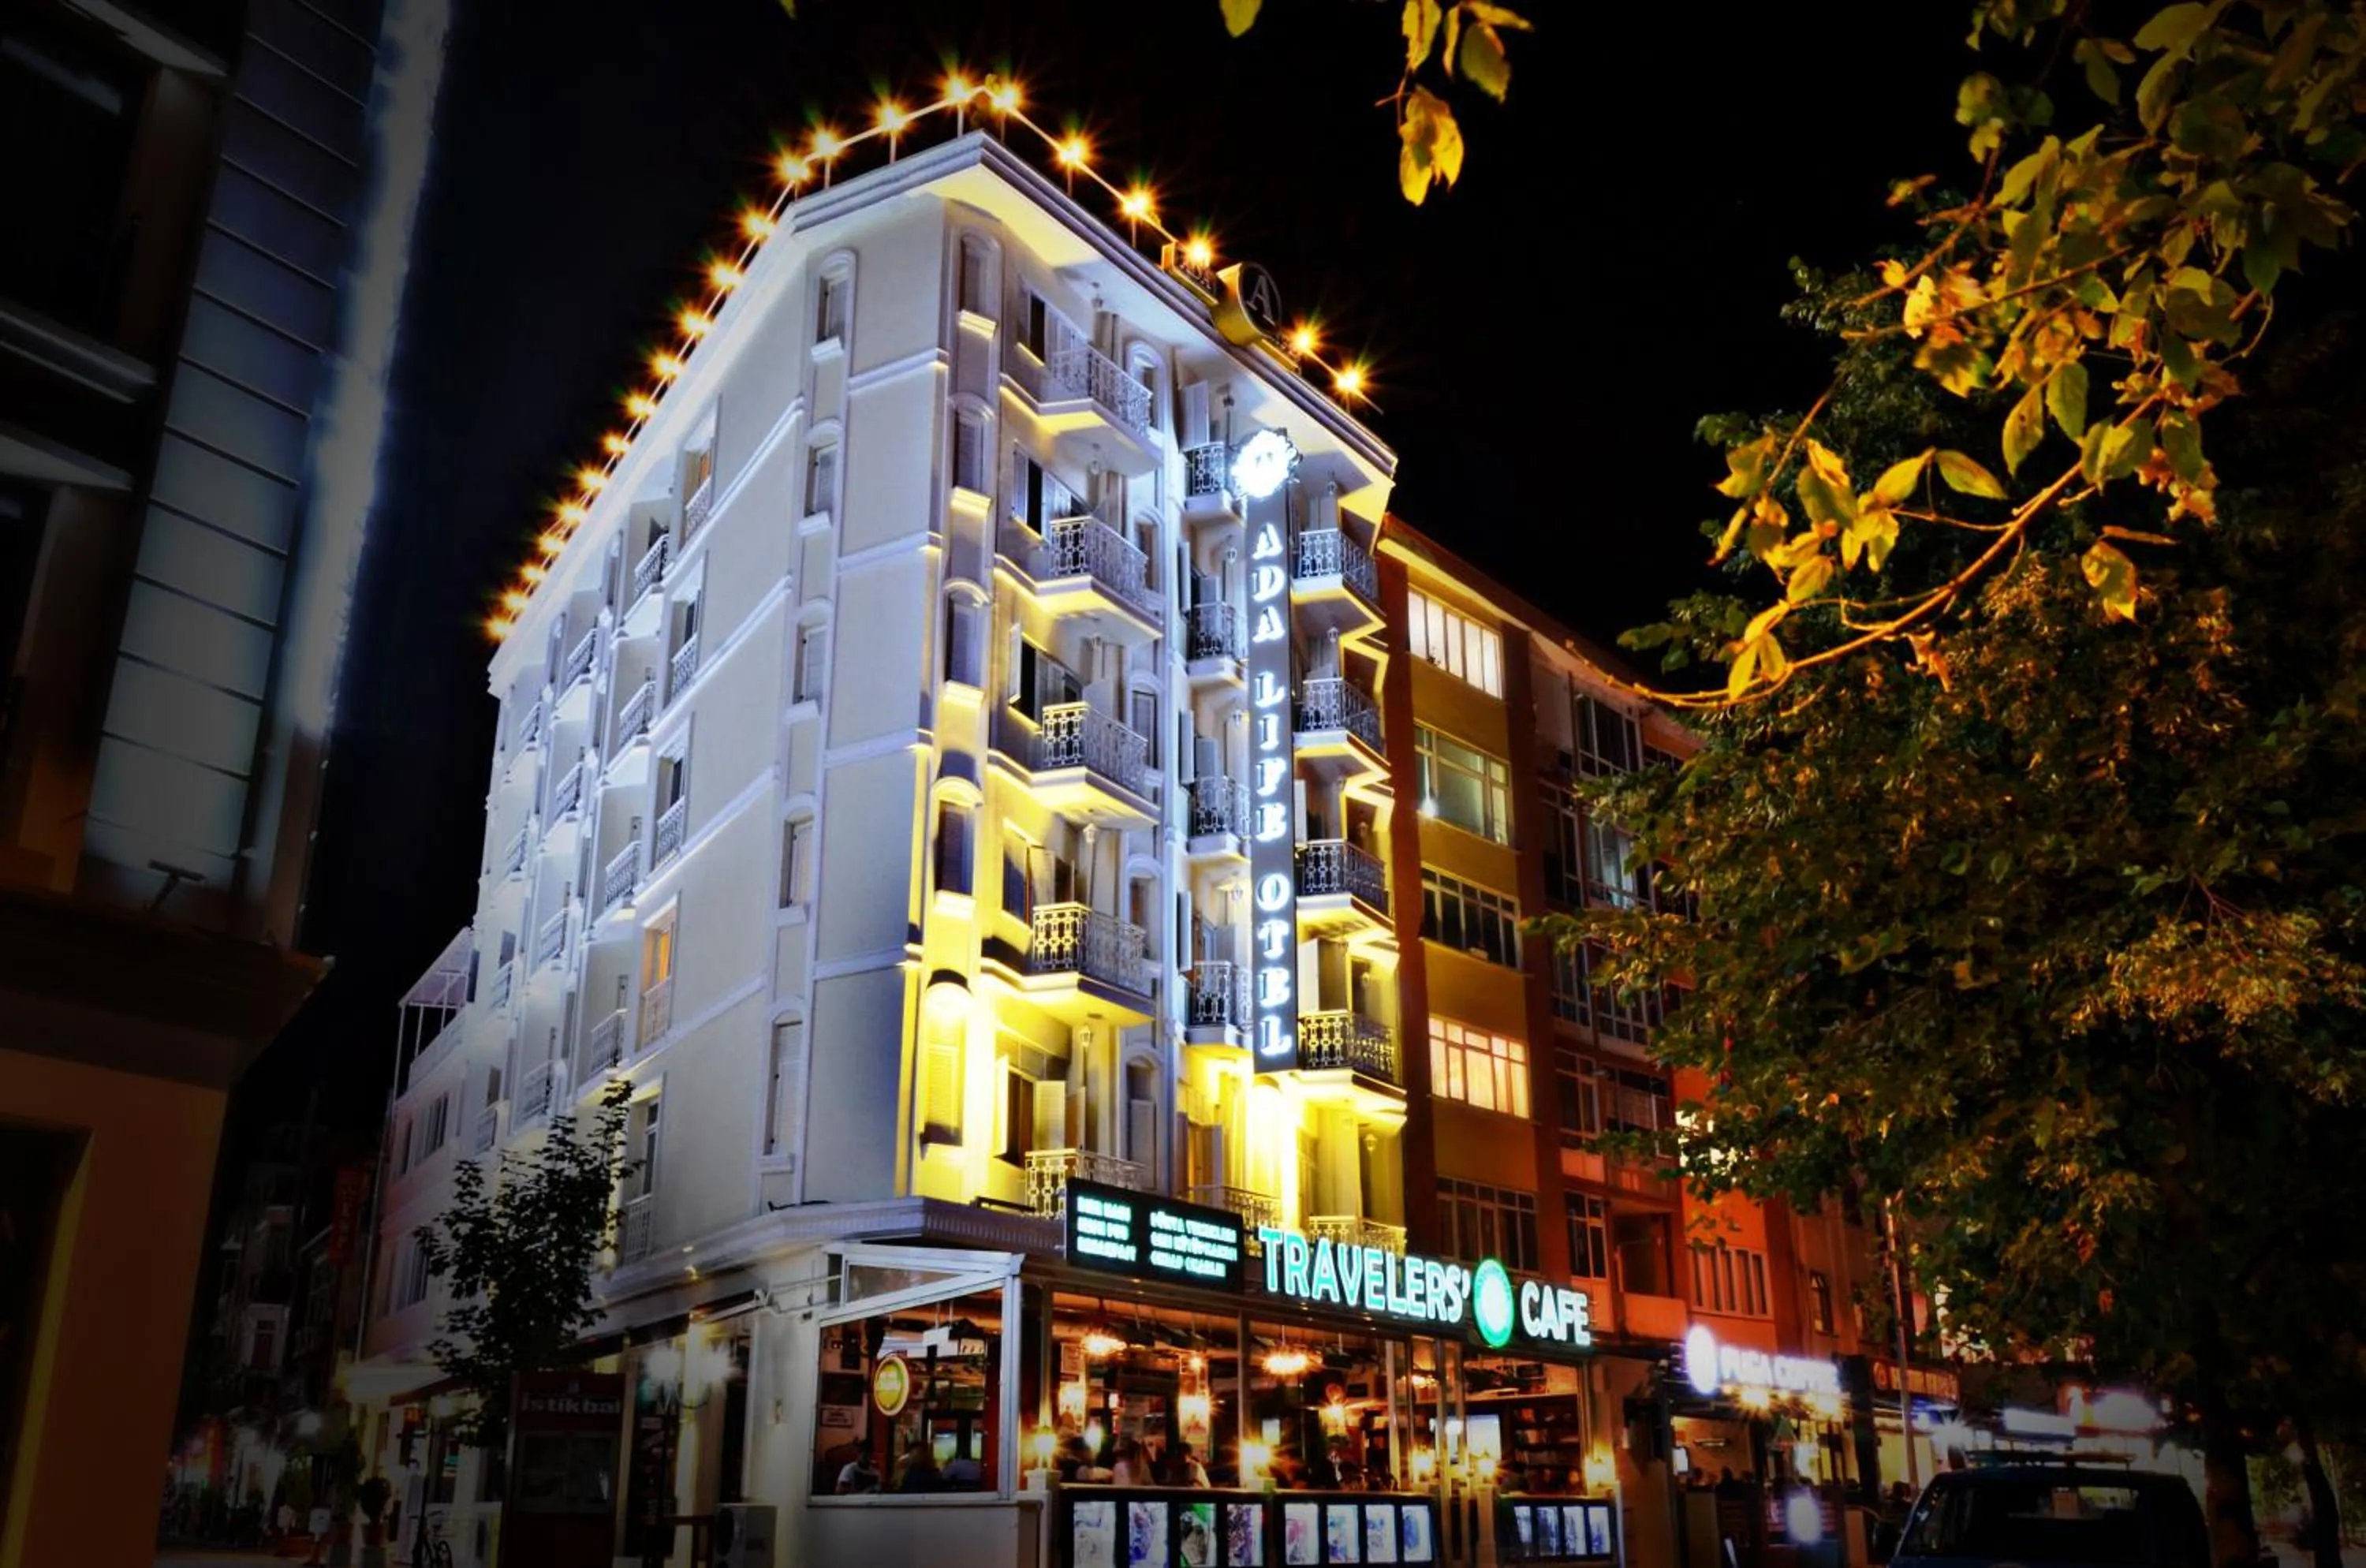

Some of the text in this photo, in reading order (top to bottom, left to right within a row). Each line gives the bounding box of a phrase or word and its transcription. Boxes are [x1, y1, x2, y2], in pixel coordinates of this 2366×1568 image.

[1252, 522, 1285, 644] ADA
[1256, 872, 1293, 1057] OTEL
[1258, 1226, 1592, 1347] TRAVELERS' CAFE
